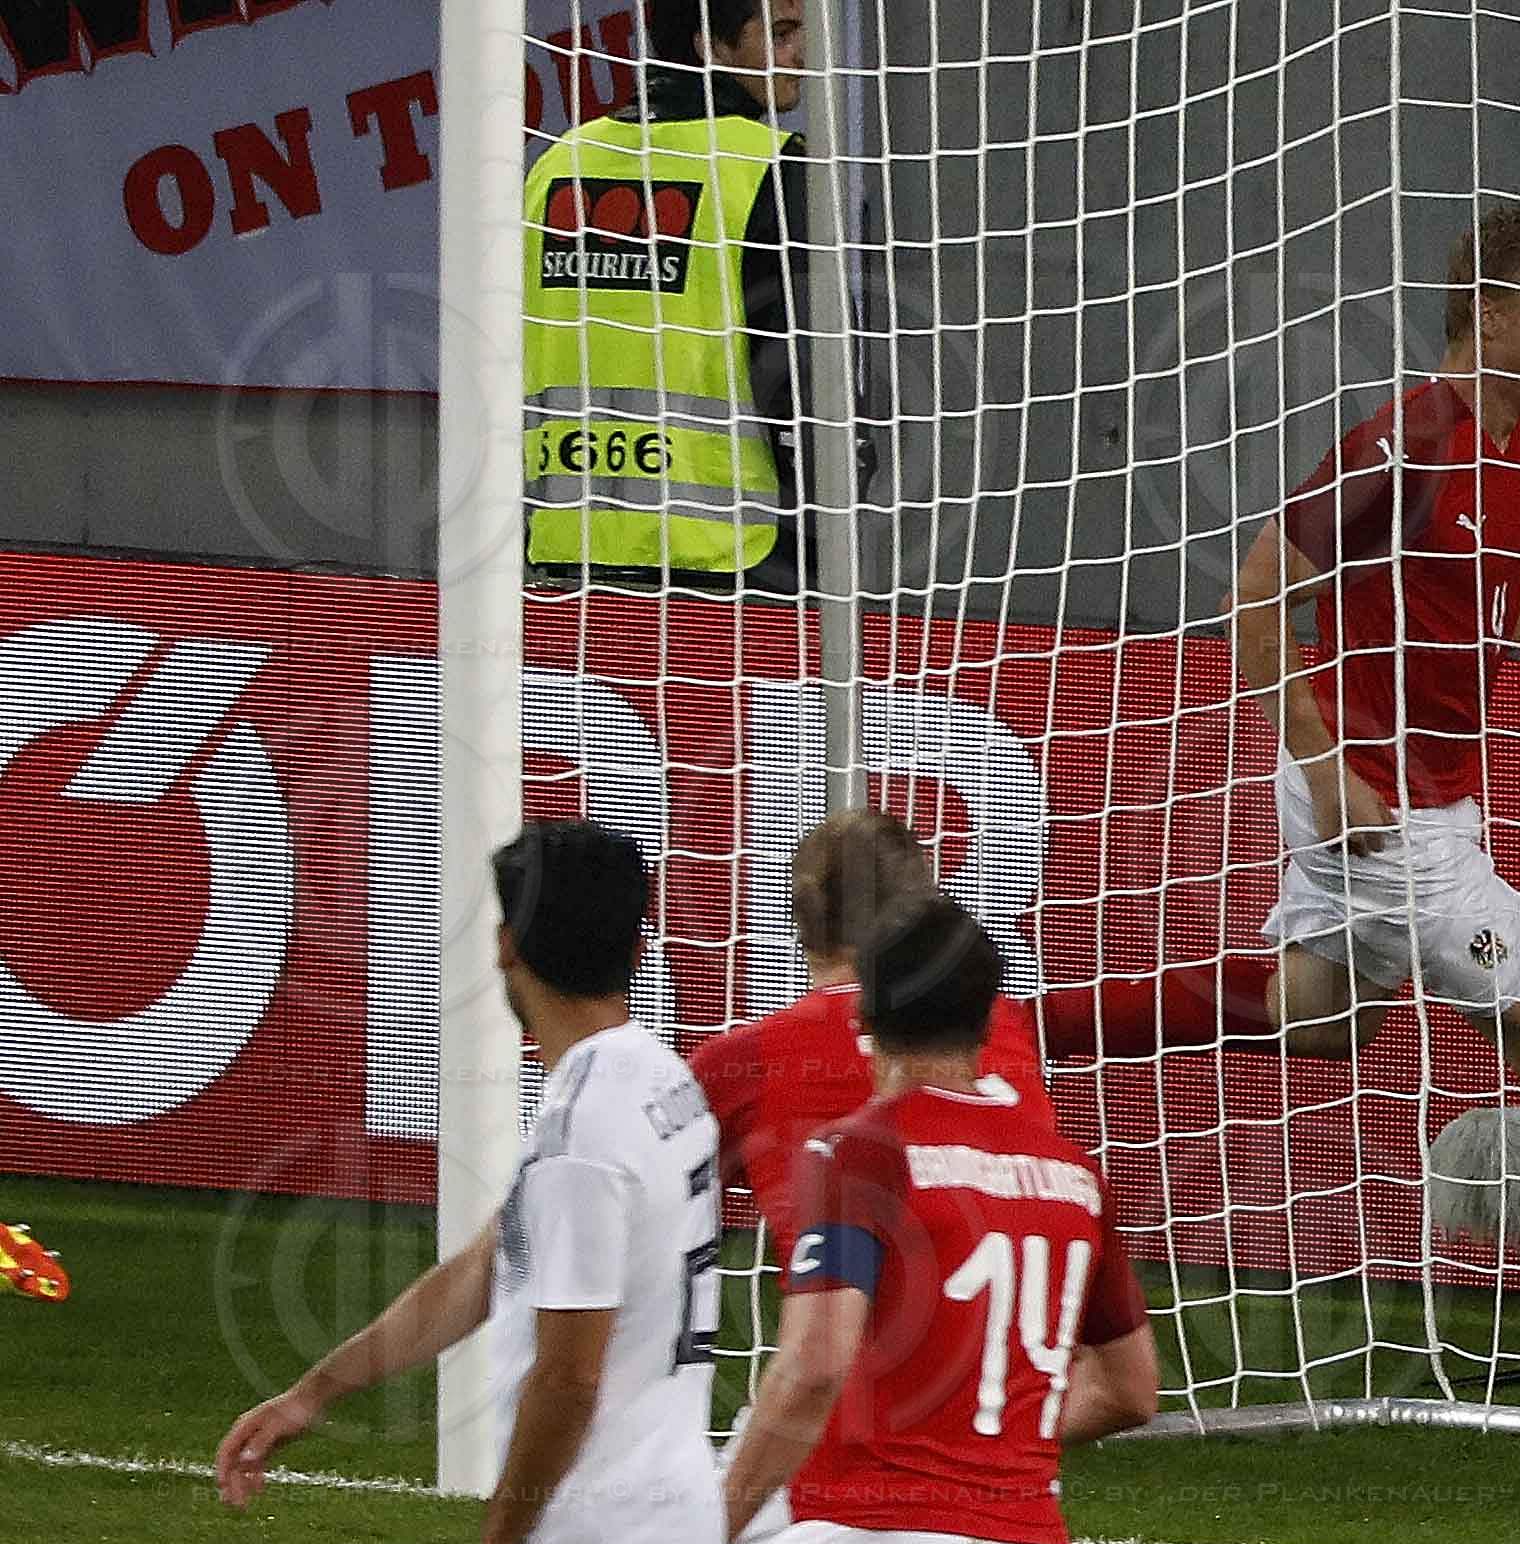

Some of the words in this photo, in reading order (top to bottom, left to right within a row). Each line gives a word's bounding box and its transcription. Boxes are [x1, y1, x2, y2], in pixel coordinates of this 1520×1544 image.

[122, 108, 322, 256] ON
[543, 251, 682, 283] SECURITAS
[942, 1230, 1095, 1441] 14
